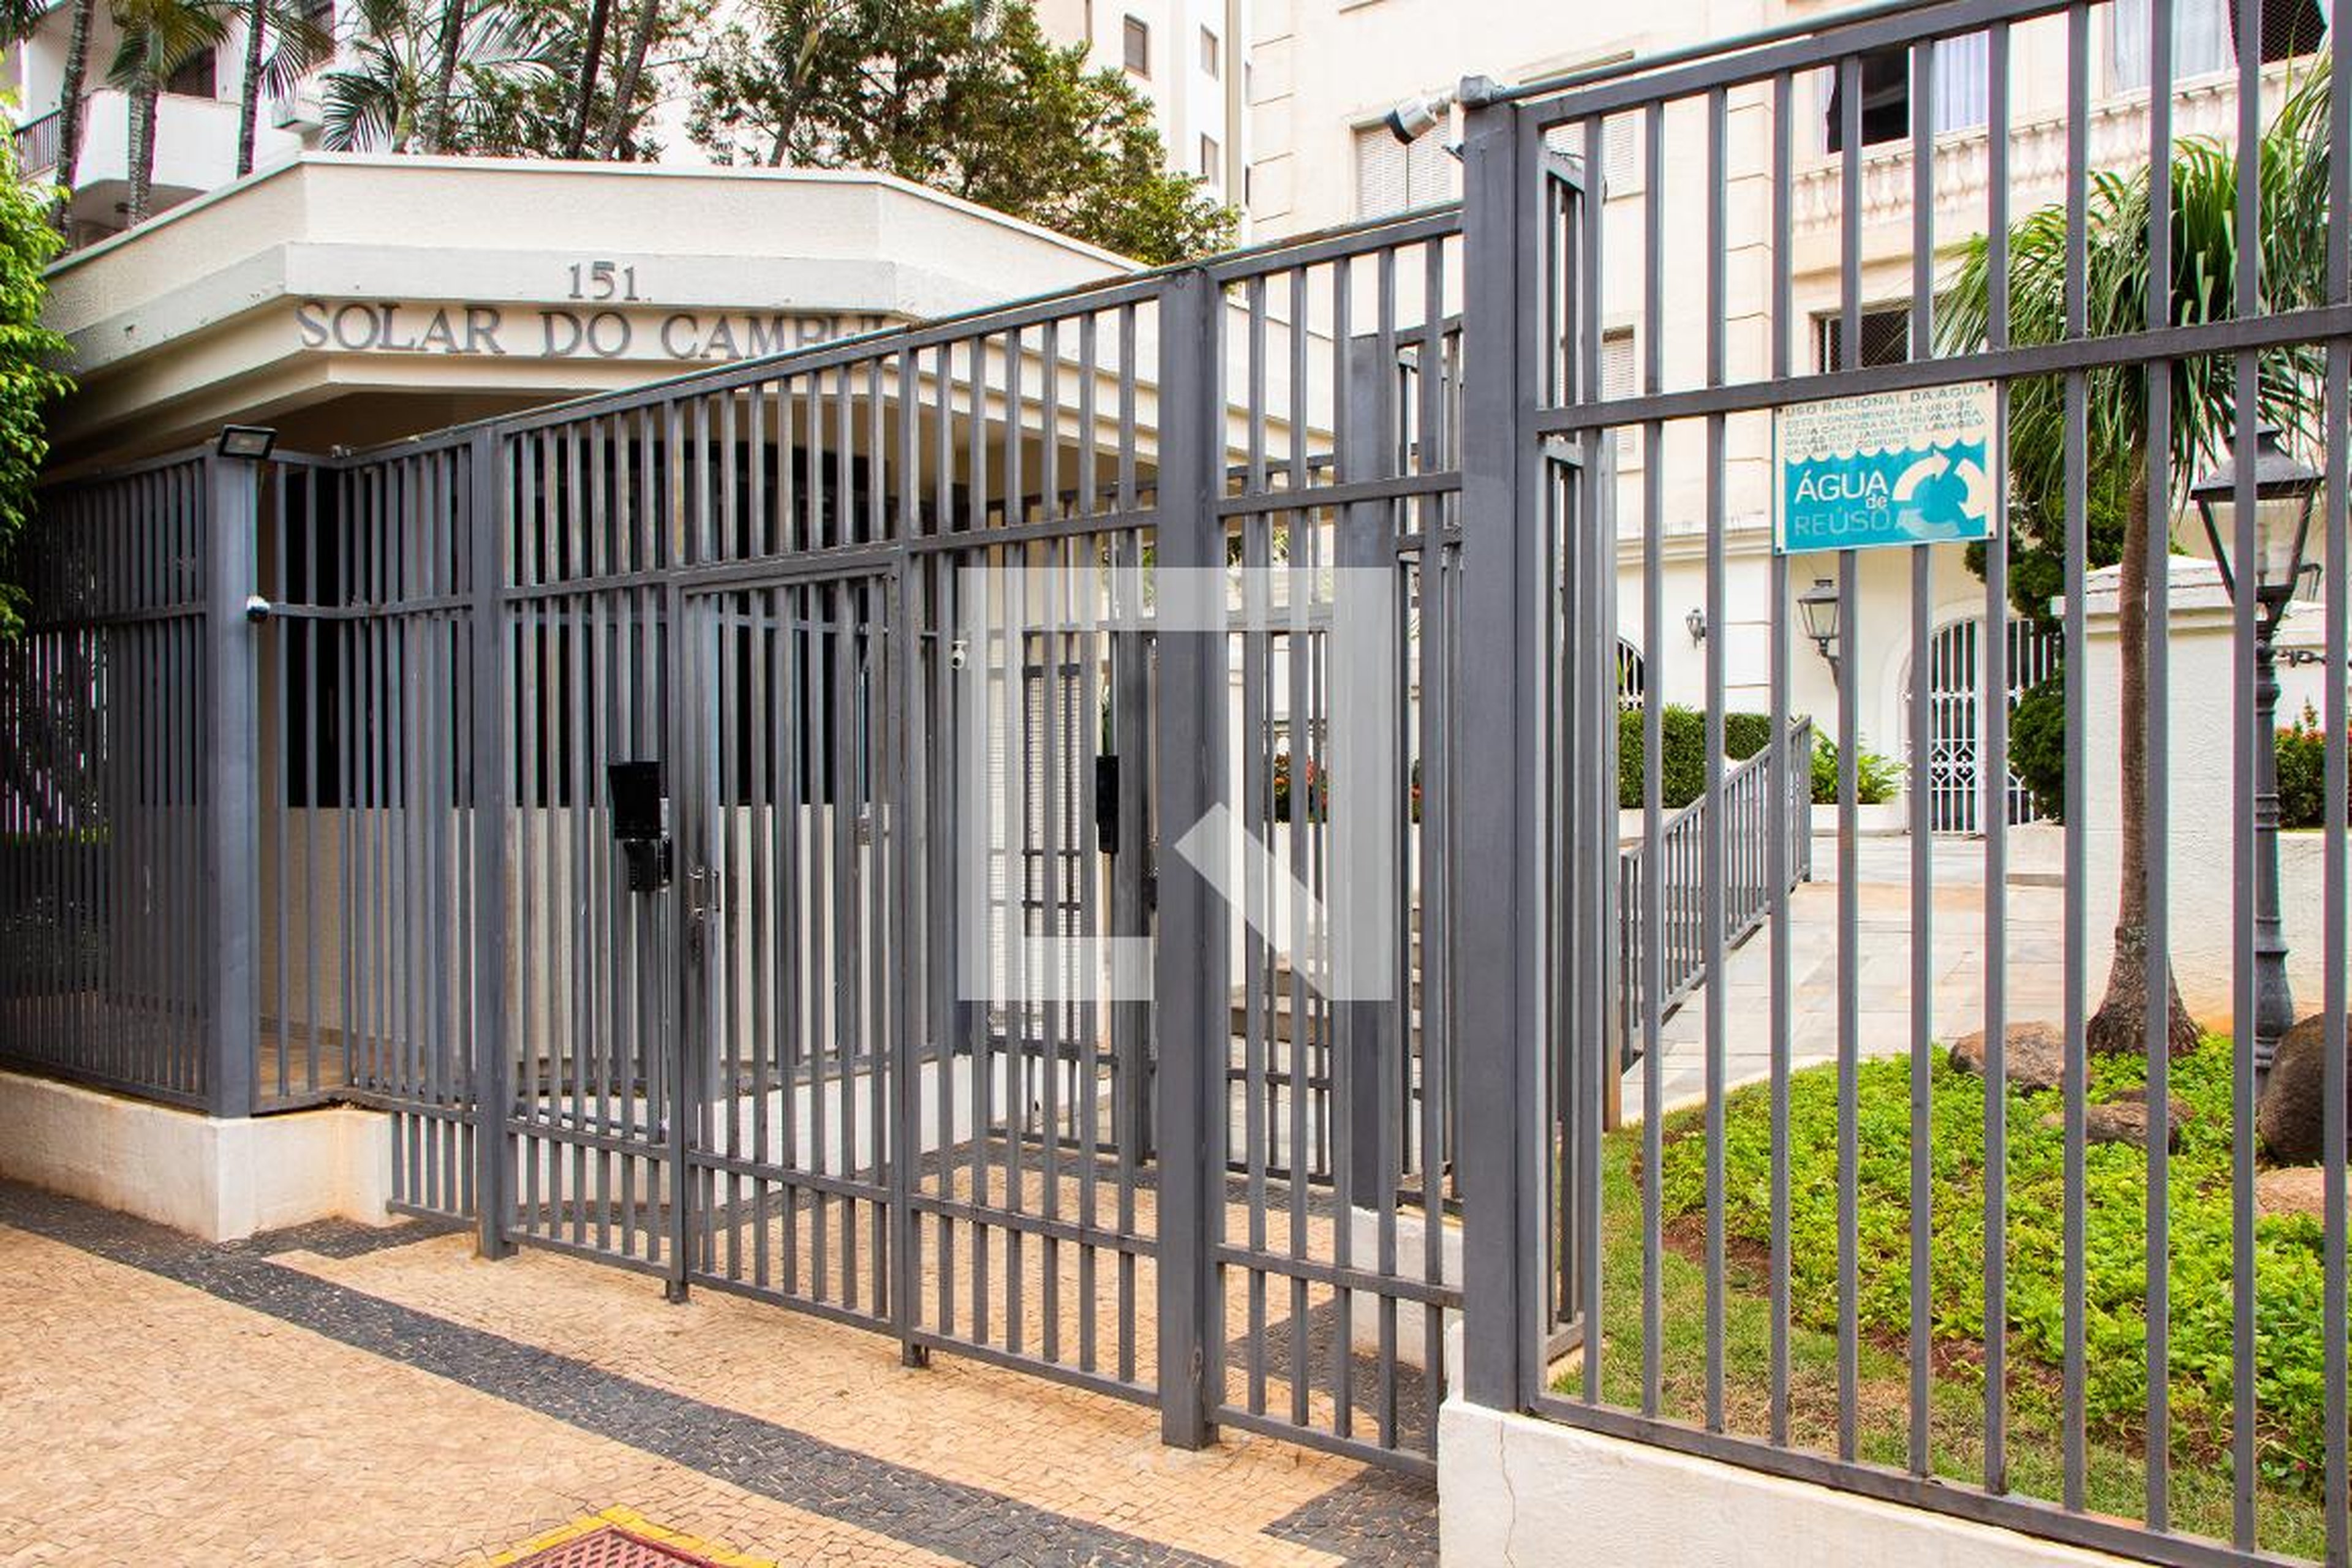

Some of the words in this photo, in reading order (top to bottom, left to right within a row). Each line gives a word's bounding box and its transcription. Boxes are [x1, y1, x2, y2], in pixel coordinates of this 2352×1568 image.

[568, 261, 639, 301] 151
[295, 299, 507, 354] SOLAR
[539, 311, 631, 358] DO
[1822, 395, 1900, 413] RACIONAL
[1910, 391, 1931, 403] DA
[1794, 469, 1889, 504] ÁGUA
